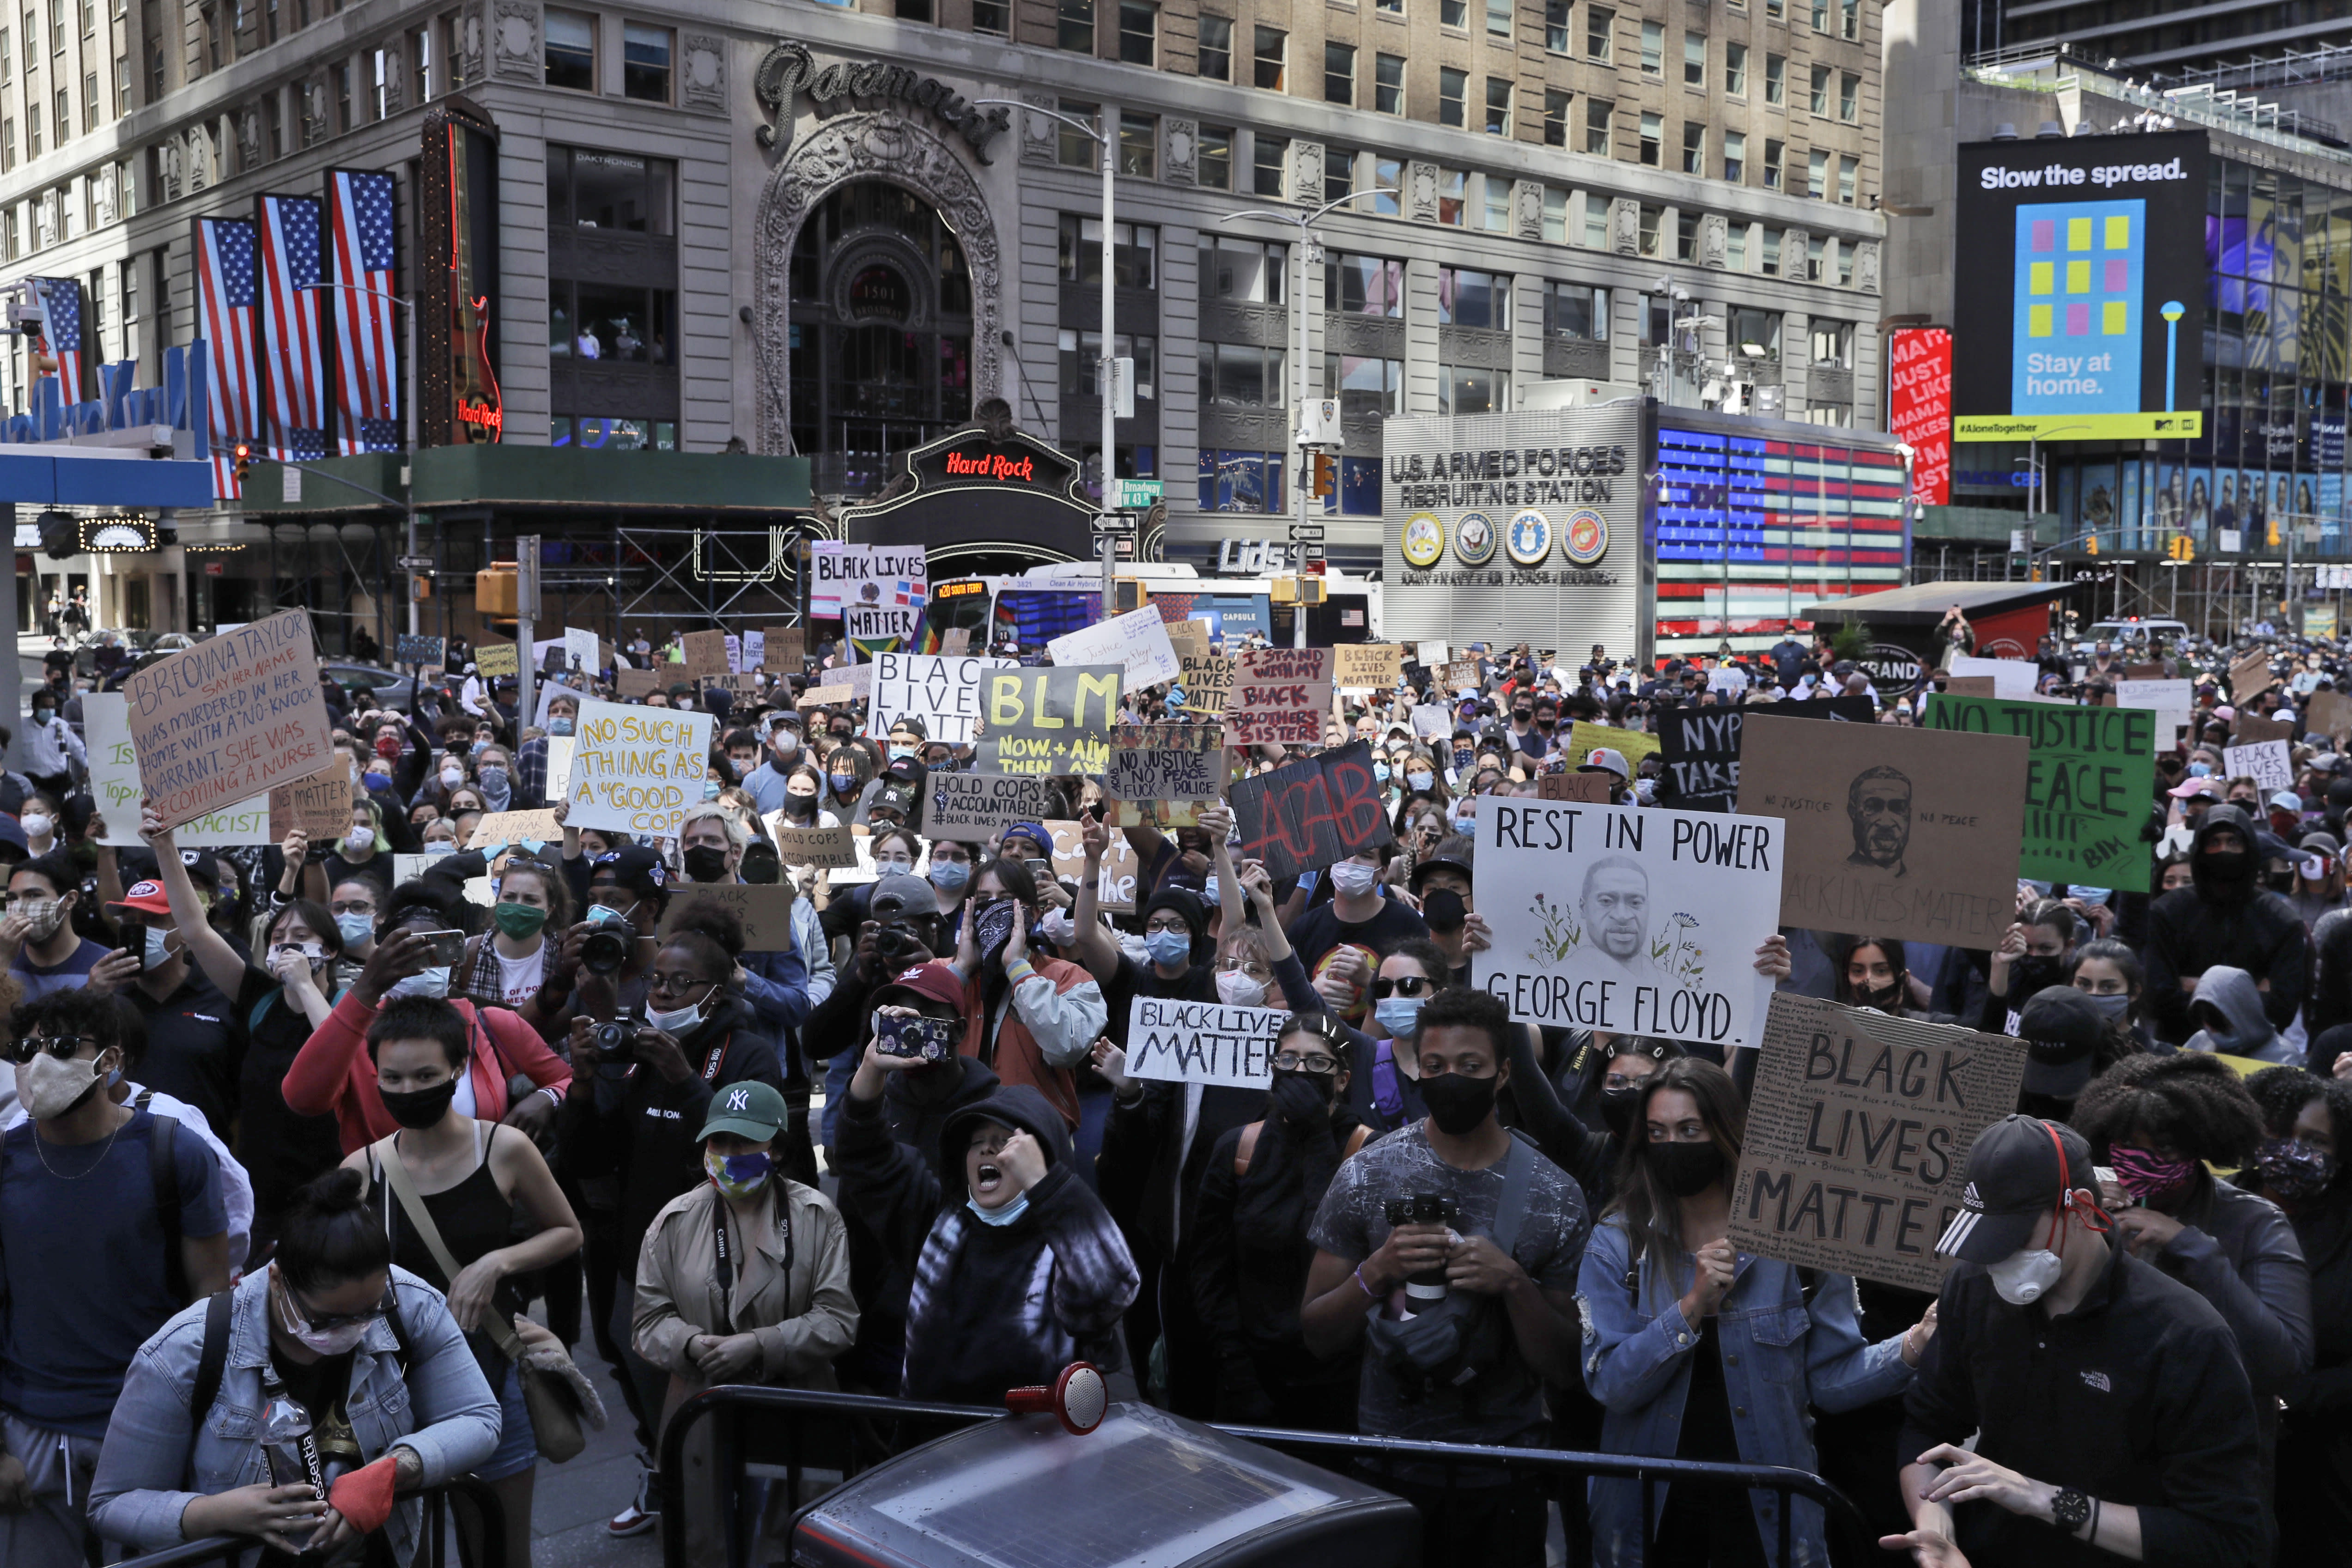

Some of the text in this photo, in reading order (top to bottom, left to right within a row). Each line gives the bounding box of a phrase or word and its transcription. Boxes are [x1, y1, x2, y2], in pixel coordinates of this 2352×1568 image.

[754, 45, 1010, 165] Paramount
[577, 153, 644, 169] DAKTRONICS
[1981, 157, 2188, 189] Slow the spread.
[865, 285, 894, 300] 1501
[856, 305, 903, 319] BROADWAY
[1892, 356, 1943, 391] JUST
[2027, 352, 2112, 377] Stay at
[2027, 375, 2103, 396] home.
[458, 399, 501, 430] Hard Rock
[1891, 400, 1946, 431] MAMA
[1960, 422, 2037, 434] #AloneTogether
[947, 452, 1033, 480] Hard Rock
[1390, 445, 1625, 482] U.S. ARMED FORCES
[1123, 492, 1141, 505] W 43
[1124, 481, 1161, 496] Broadway
[1401, 478, 1612, 507] RECRUITING STATION
[1218, 538, 1285, 573] Lids
[819, 555, 926, 580] BLACK LIVES
[939, 583, 982, 598] M20 SOUTH FERRY
[1077, 580, 1098, 589] Hybrid
[850, 611, 913, 636] MATTER
[1223, 613, 1256, 621] CAPSULE
[687, 646, 721, 656] JUSTICE
[695, 636, 710, 644] NO
[765, 635, 803, 644] PROSECUTE
[765, 655, 801, 665] POLICE
[1083, 641, 1123, 662] Justice
[1242, 649, 1325, 667] I STAND
[1344, 650, 1393, 662] BLACK
[134, 614, 306, 717] BREONNA TAYLOR
[202, 647, 297, 699] SAY HER NAME
[1182, 657, 1236, 674] BLACK
[1252, 661, 1323, 680] WITH MY
[1352, 663, 1386, 673] LIVES
[703, 676, 739, 688] I AM
[1187, 673, 1234, 687] LIVES
[1343, 675, 1392, 685] MATTER
[1448, 677, 1478, 686] MATTER
[991, 672, 1118, 731] BLM
[1241, 684, 1309, 707] BLACK
[136, 670, 302, 753] WAS MURDERED HER
[1232, 709, 1320, 732] BROTHERS
[581, 716, 693, 750] NO SUCH
[1240, 726, 1321, 743] SISTERS
[1683, 712, 1742, 751] NYP
[2002, 707, 2148, 756] JUSTICE
[140, 716, 238, 778] HOME WITH A
[2234, 742, 2277, 763] BLACK
[144, 720, 305, 802] WARRANT. SHE WAS
[577, 748, 704, 782] THING AS
[998, 759, 1052, 774] THEN
[1119, 750, 1204, 773] NO JUSTICE
[2236, 759, 2283, 777] LIVES
[245, 764, 256, 785] A
[1110, 767, 1121, 793] ACAB
[1132, 767, 1209, 784] NO PEACE
[1670, 760, 1740, 795] TAKE
[295, 780, 347, 808] MATTER
[573, 781, 684, 810] A "GOOD
[886, 790, 898, 802] NY
[935, 776, 1042, 802] HOLD COPS
[1124, 780, 1216, 798] FUCK THE POLICE
[1544, 777, 1591, 802] BLACK
[2025, 760, 2129, 817] EACE
[950, 796, 1044, 817] ACCOUNTABLE
[1765, 794, 1833, 812] NO JUSTICE
[932, 811, 997, 827] #BLACK LIVES
[1243, 763, 1383, 867] ACAB
[1920, 812, 1979, 827] NO PEACE
[782, 832, 839, 845] HOLD COPS
[1496, 806, 1770, 872] REST IN POWER
[784, 852, 853, 866] ACCOUNTABLE
[1839, 877, 2006, 937] LIVES MATTER
[194, 1012, 219, 1022] Logistics
[1140, 1002, 1216, 1030] BLACK
[1487, 972, 1742, 1044] GEORGE FLOYD.
[705, 1048, 722, 1078] EOS 80D
[1573, 1045, 1588, 1070] Nikon
[1805, 1033, 1972, 1109] BLACK
[726, 1088, 749, 1111] NY
[1762, 1075, 1879, 1104] Philando Castile Rice
[1805, 1100, 1953, 1186] LIVES
[1748, 1146, 1888, 1182] George Floyd Breonna Taylor
[2080, 1372, 2104, 1382] NORTH
[2085, 1380, 2104, 1389] FACE
[304, 1434, 325, 1501] essentia
